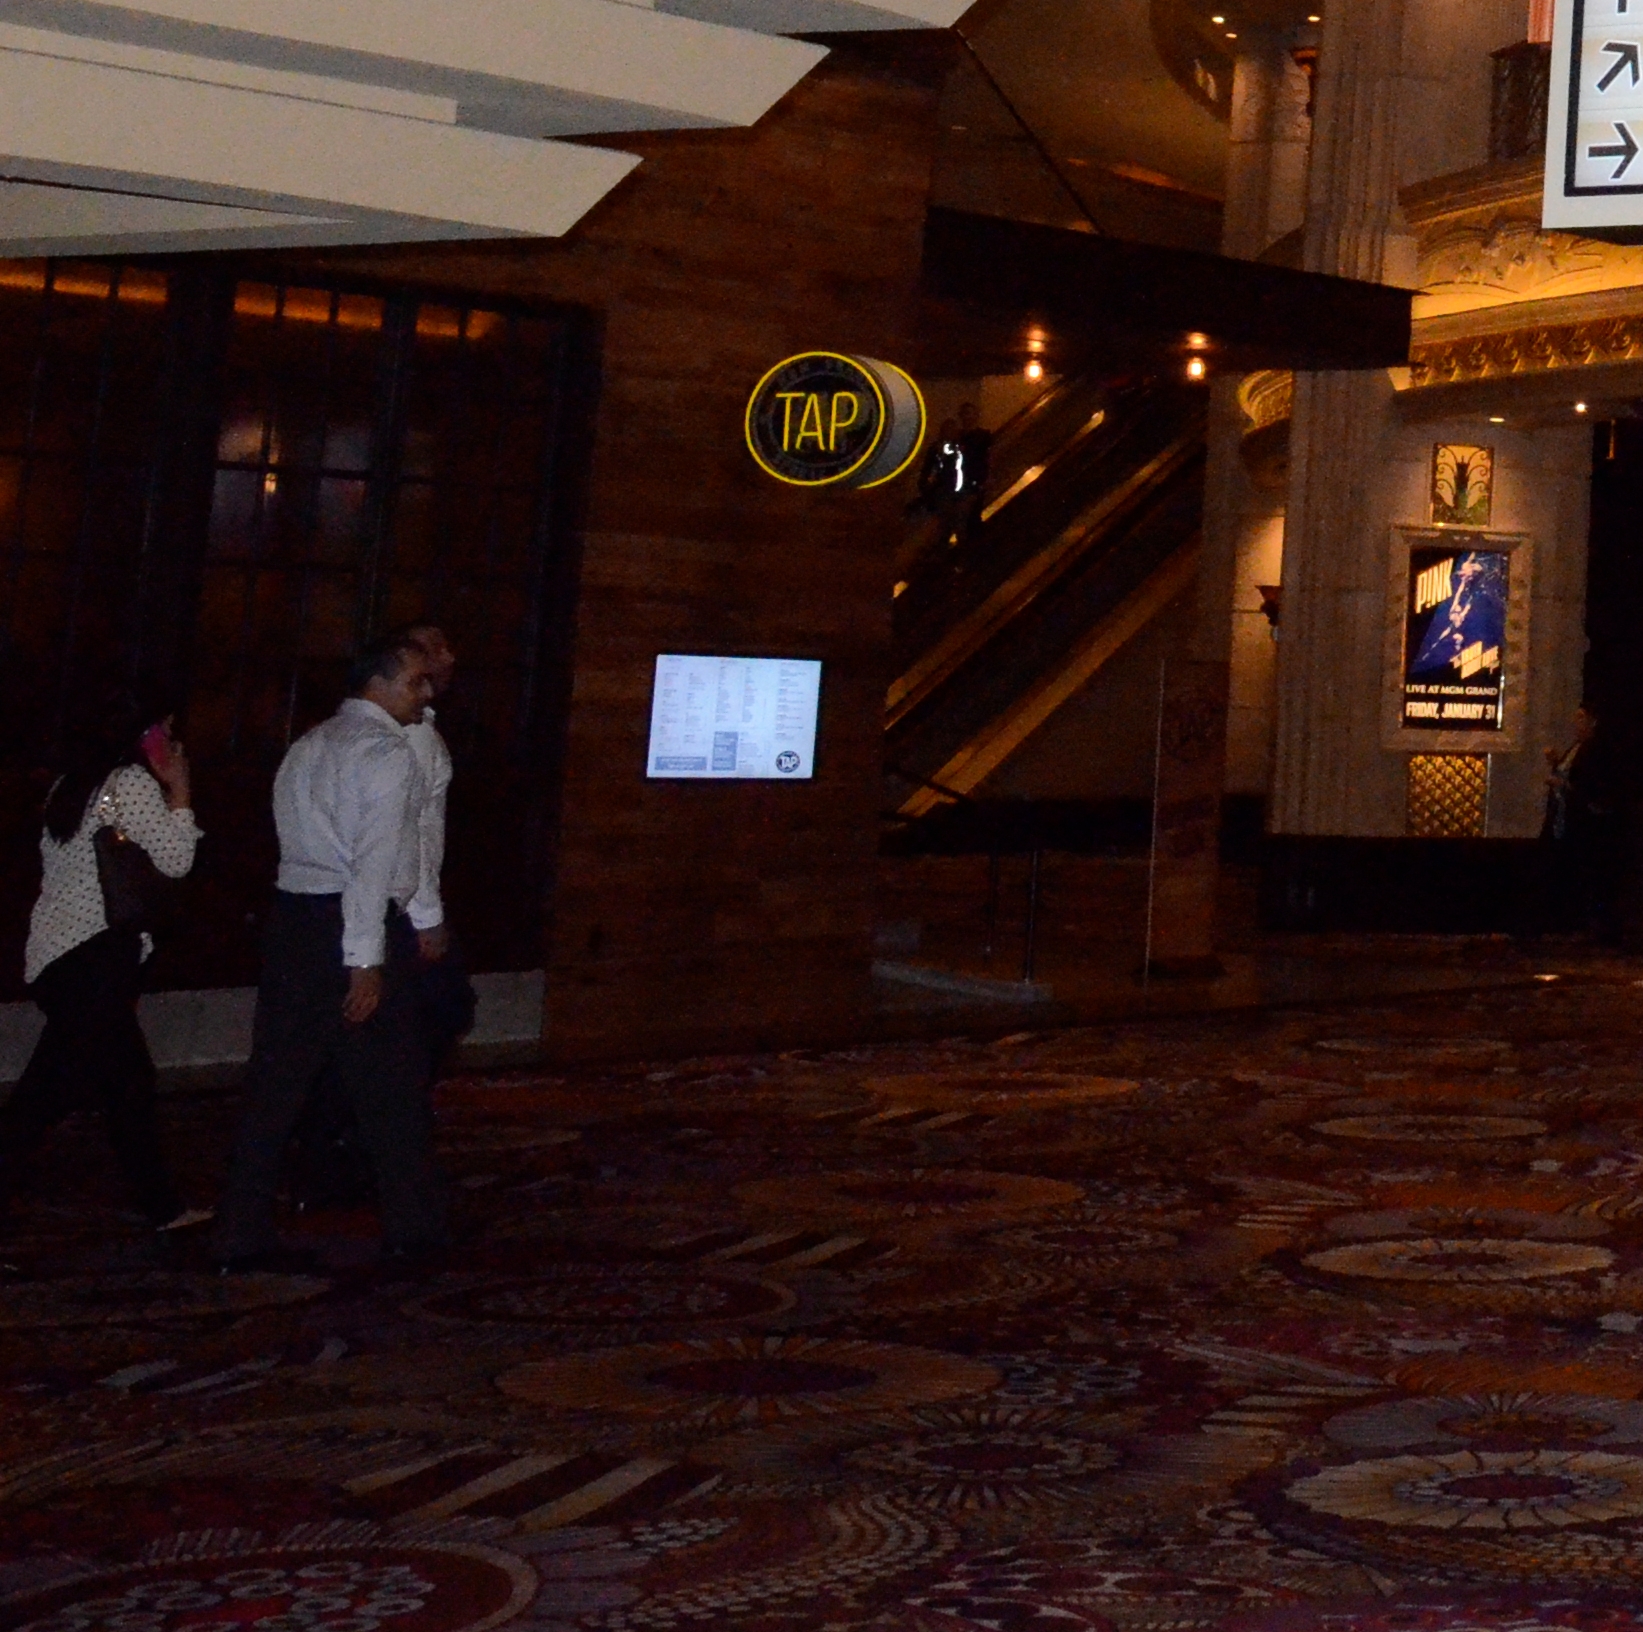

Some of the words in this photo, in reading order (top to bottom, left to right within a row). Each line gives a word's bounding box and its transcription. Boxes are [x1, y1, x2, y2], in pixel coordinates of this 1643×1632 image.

[775, 390, 859, 452] TAP
[1415, 557, 1454, 614] P!NK
[1405, 684, 1427, 694] LIVE
[1427, 685, 1441, 694] AT
[1441, 702, 1485, 720] JANUARY
